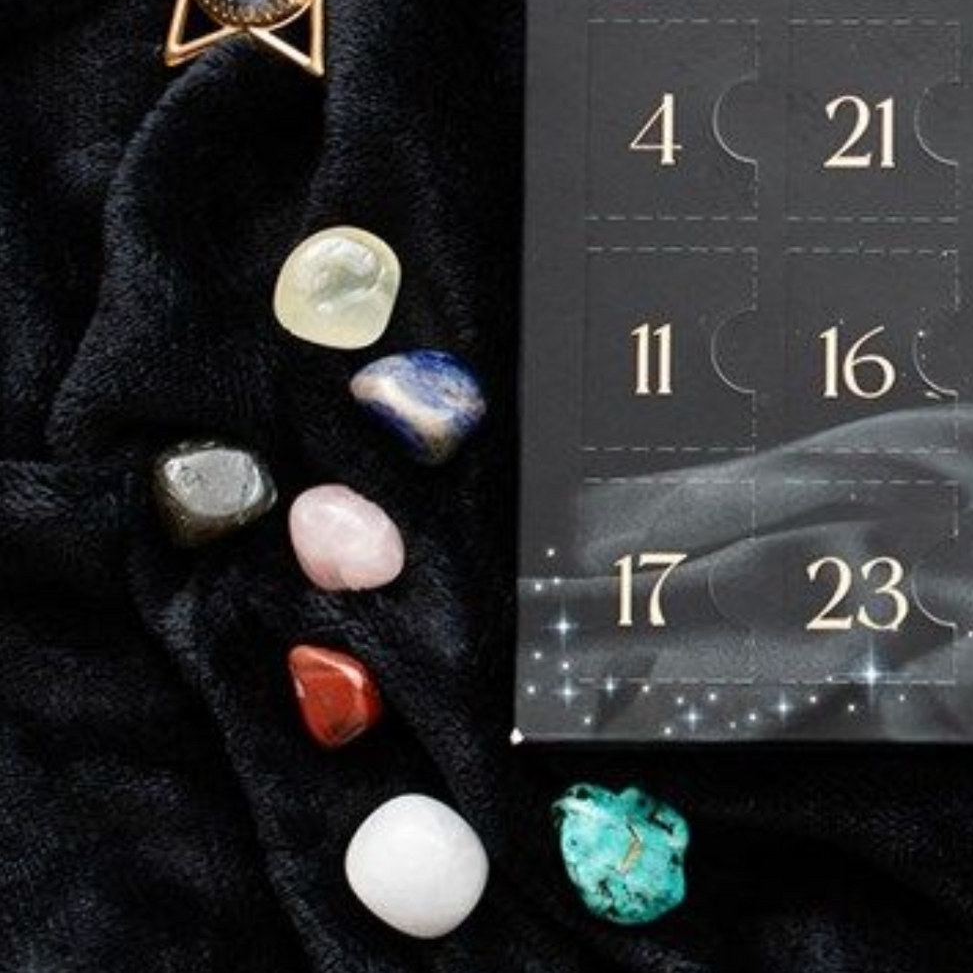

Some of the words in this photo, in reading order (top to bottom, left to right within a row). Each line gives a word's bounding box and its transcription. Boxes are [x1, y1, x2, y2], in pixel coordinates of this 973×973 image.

[629, 93, 683, 165] 4
[823, 95, 895, 168] 21
[630, 322, 672, 395] 11
[819, 325, 896, 399] 16
[615, 553, 687, 627] 17
[806, 556, 908, 632] 23
